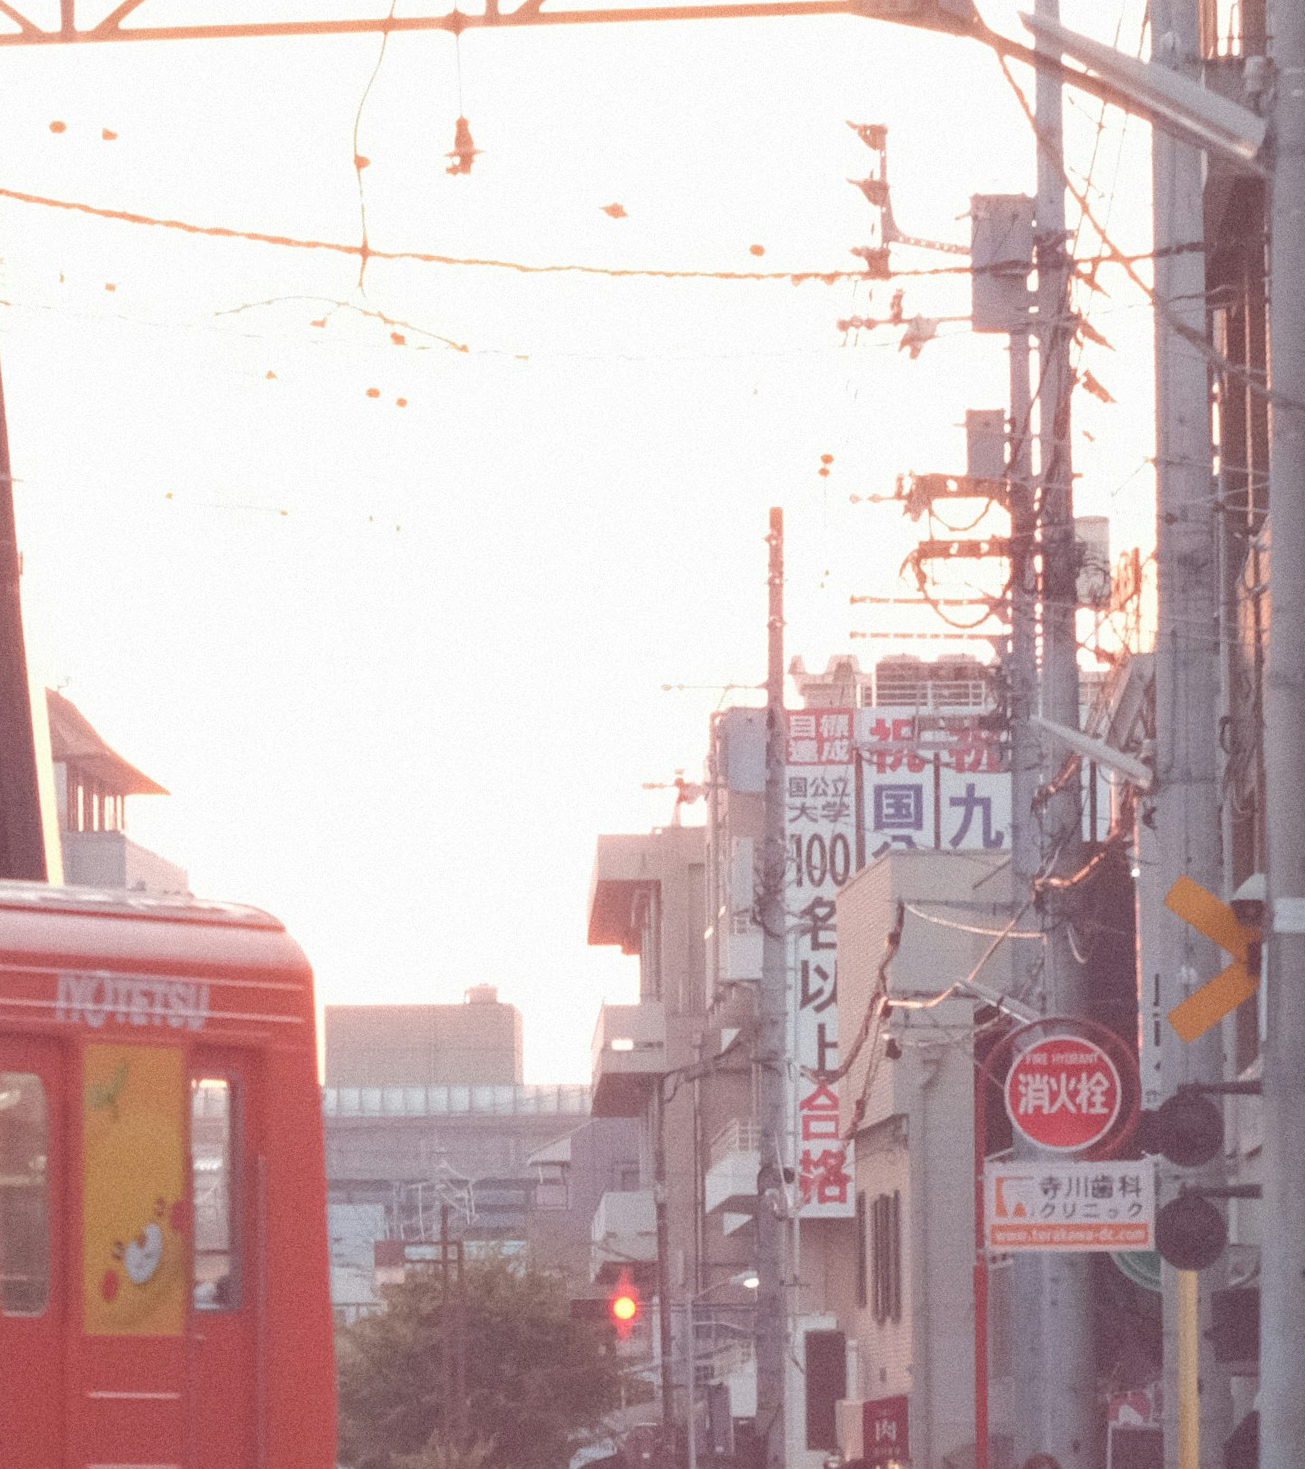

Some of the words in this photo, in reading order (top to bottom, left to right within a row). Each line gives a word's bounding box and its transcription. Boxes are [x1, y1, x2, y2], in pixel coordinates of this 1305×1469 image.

[789, 777, 850, 799] 国公立
[789, 802, 851, 823] 大学
[1017, 1071, 1110, 1115] 消火栓
[1040, 1174, 1143, 1199] 寺川歯科
[1040, 1202, 1143, 1219] クリニック
